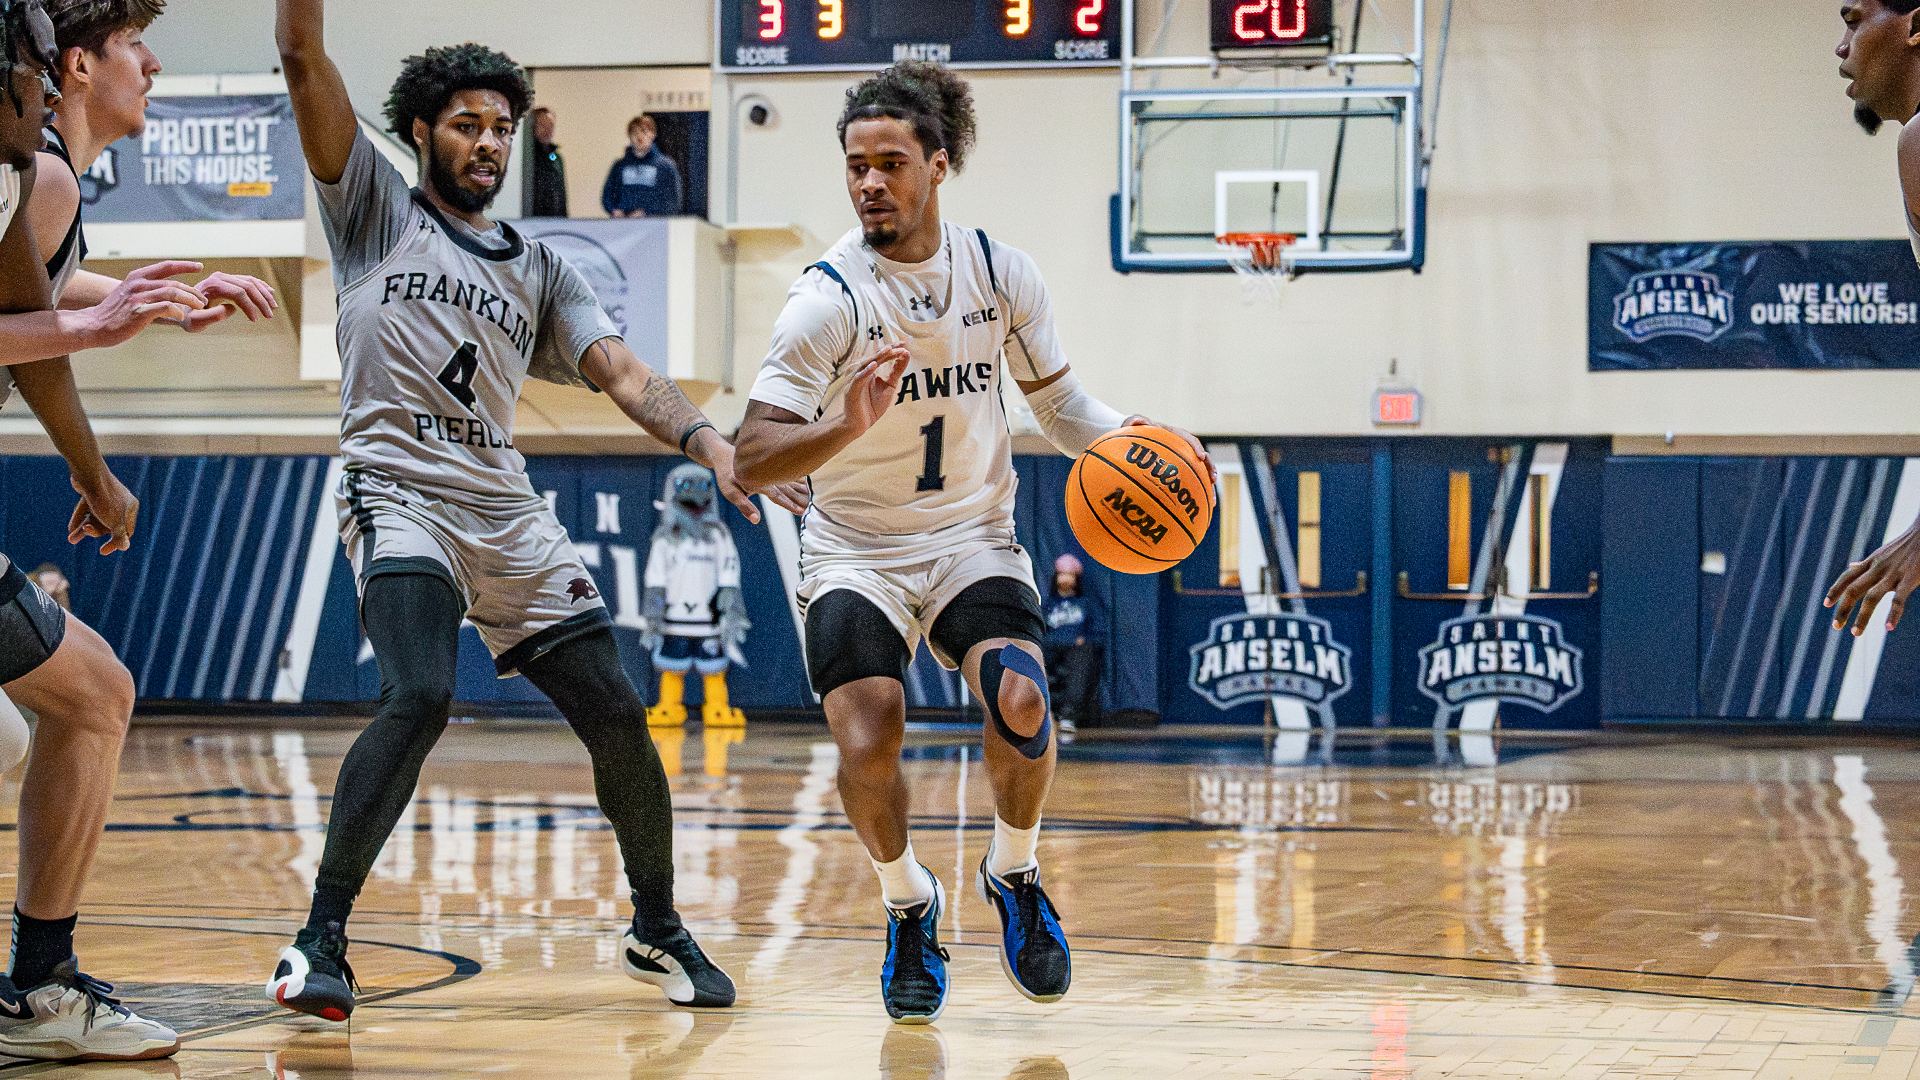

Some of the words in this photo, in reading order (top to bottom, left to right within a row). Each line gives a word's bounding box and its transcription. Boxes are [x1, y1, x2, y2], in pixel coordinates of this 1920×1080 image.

[760, 0, 783, 38] 3
[817, 0, 843, 39] 3
[1005, 0, 1030, 36] 3
[736, 46, 790, 66] SCORE
[892, 43, 952, 64] MATCH
[1054, 40, 1110, 60] SCORE
[141, 116, 281, 156] PROTECT
[142, 155, 192, 185] THIS
[195, 153, 280, 184] HOUSE.
[1620, 289, 1728, 325] ANSELM
[1777, 282, 1811, 304] WE
[1824, 282, 1890, 305] LOVE
[381, 272, 534, 360] FRANKLIN
[1750, 303, 1800, 325] OUR
[1804, 302, 1918, 325] SENIORS!
[436, 338, 481, 414] 4
[894, 363, 992, 405] AWKS
[915, 414, 947, 493] 1
[1125, 441, 1200, 524] Wilson
[1103, 487, 1168, 545] NCAA
[1449, 621, 1551, 645] SAINT
[1197, 638, 1344, 687] ANSELM
[1426, 640, 1575, 688] ANSELM
